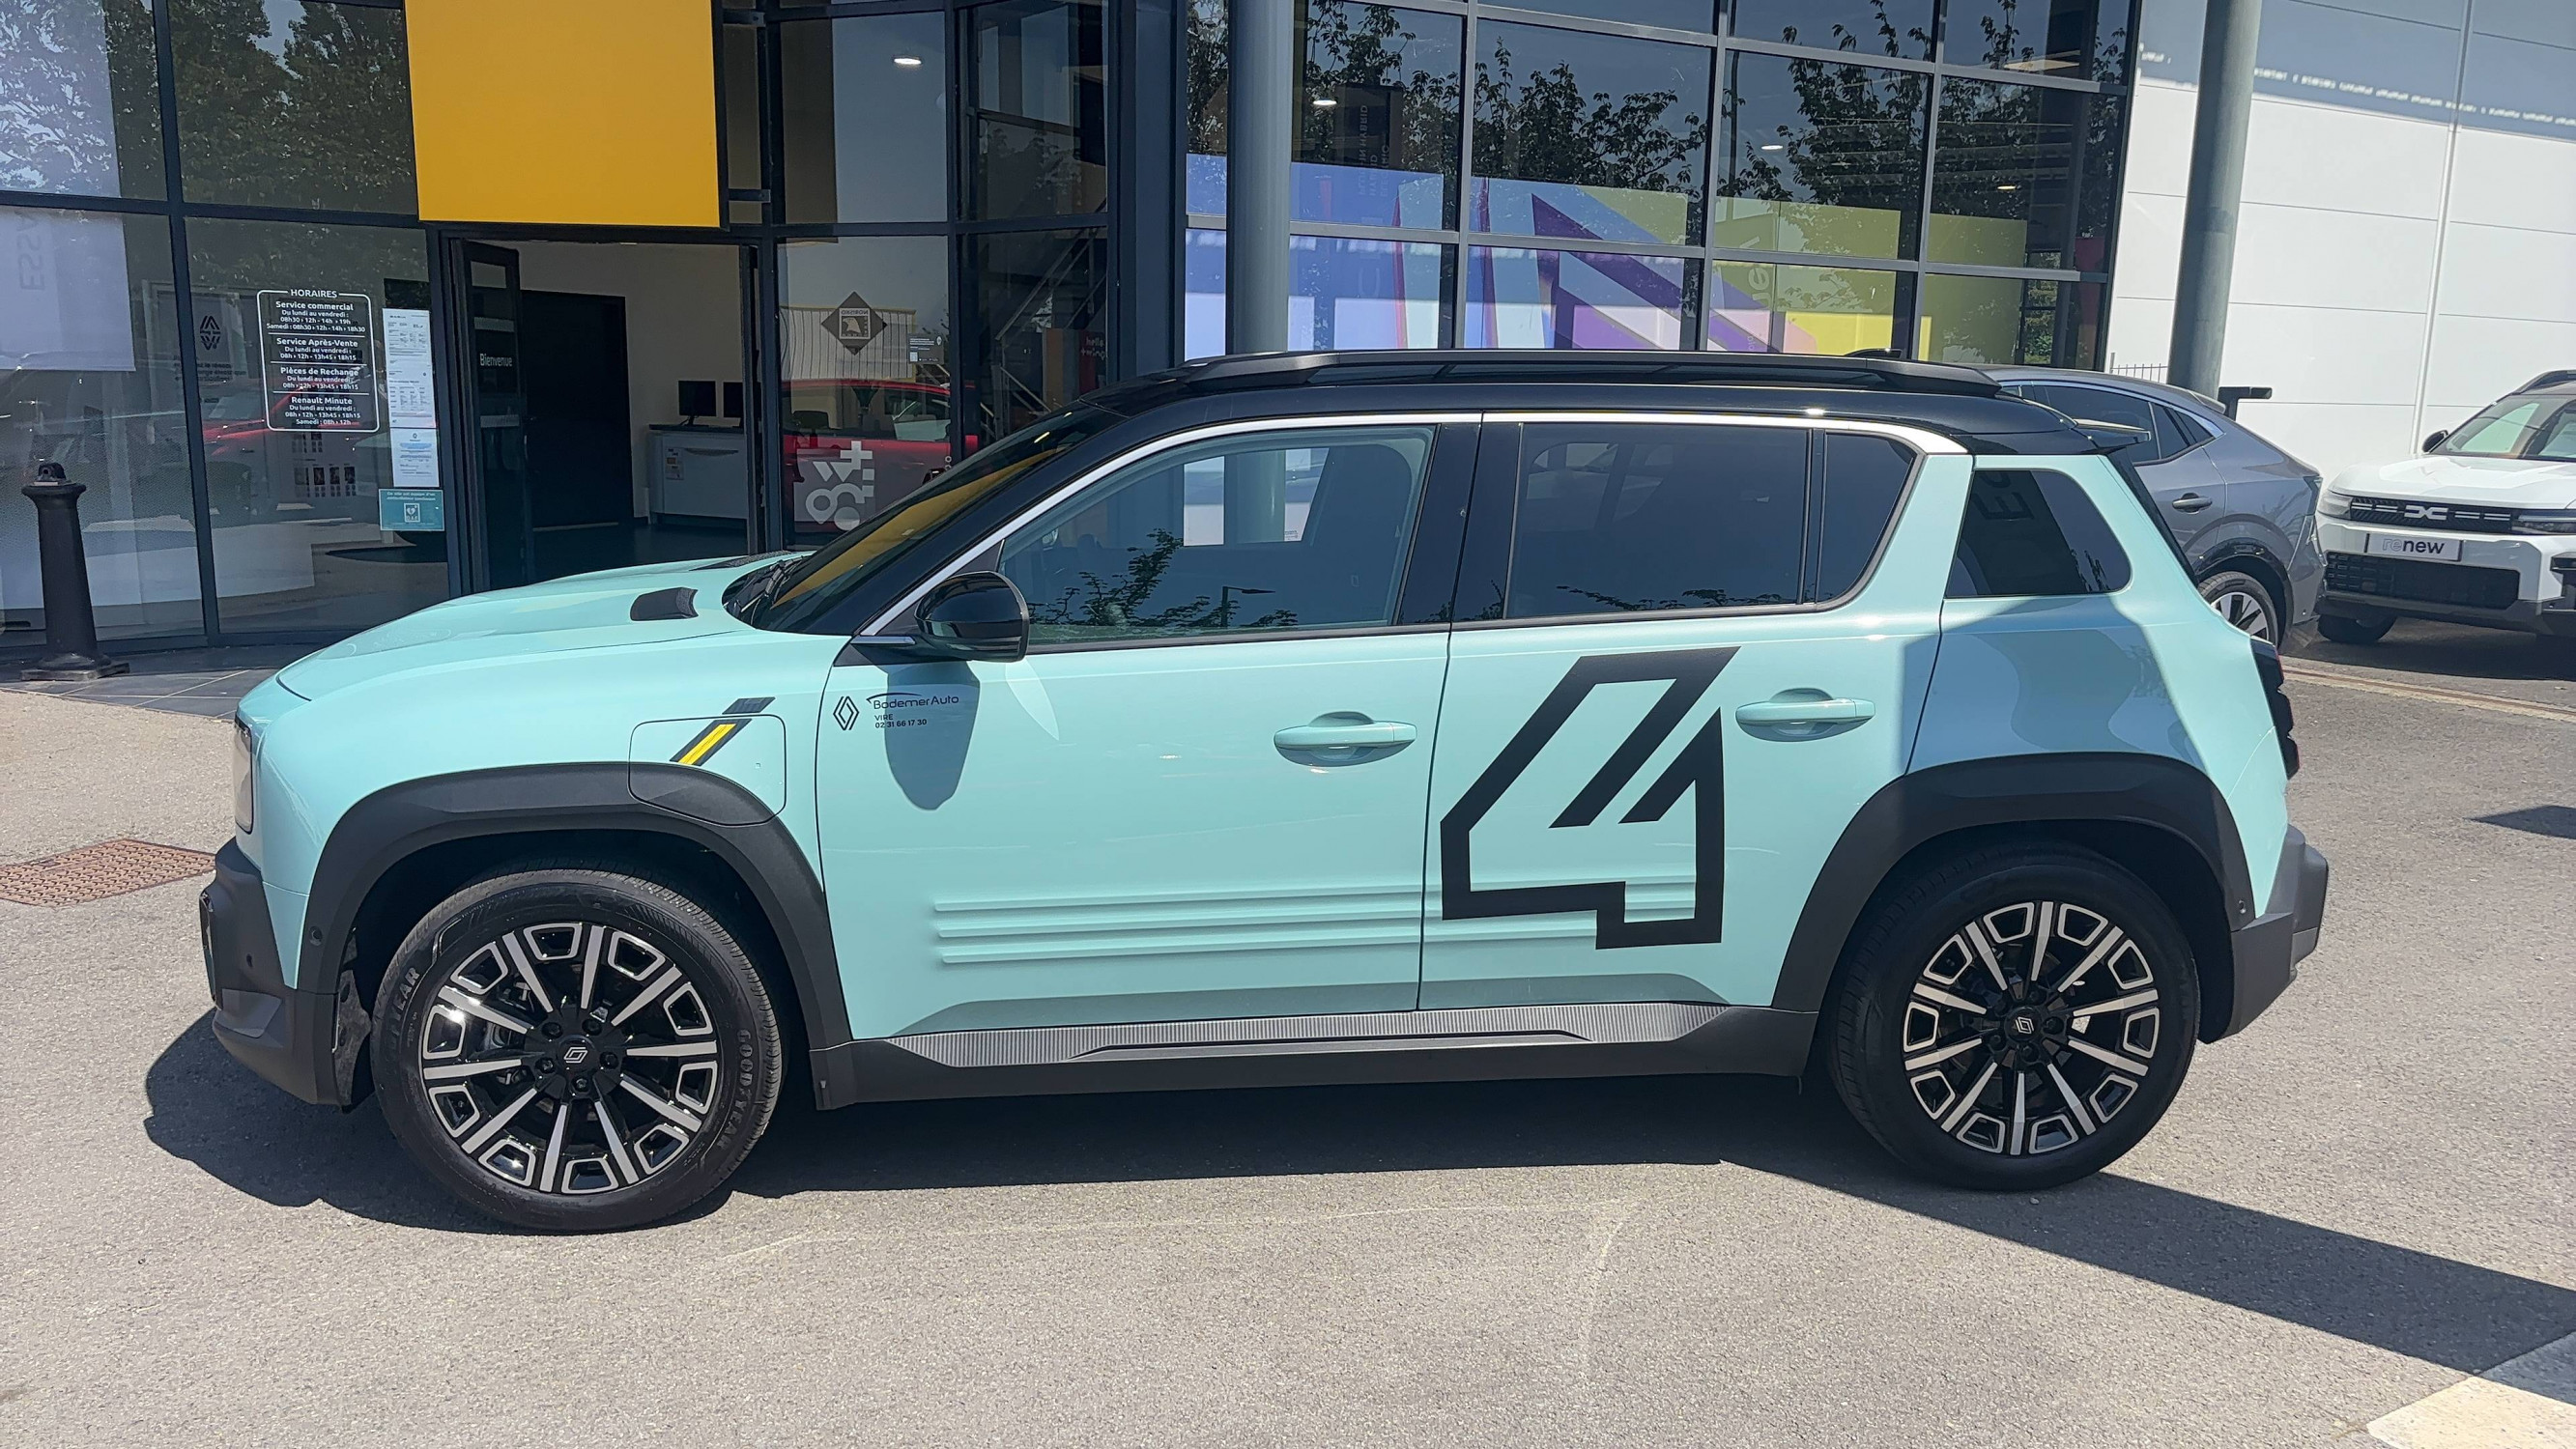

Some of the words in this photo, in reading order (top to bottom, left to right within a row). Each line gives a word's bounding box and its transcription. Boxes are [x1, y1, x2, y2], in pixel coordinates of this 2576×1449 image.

[291, 289, 337, 298] HORAIRES
[307, 301, 354, 311] commercial
[308, 338, 358, 348] Après-Vente
[479, 353, 513, 367] Bienvenue
[280, 366, 306, 375] Pièces
[320, 368, 358, 377] Rechange
[2382, 538, 2445, 554] renew
[874, 713, 894, 722] VIRE
